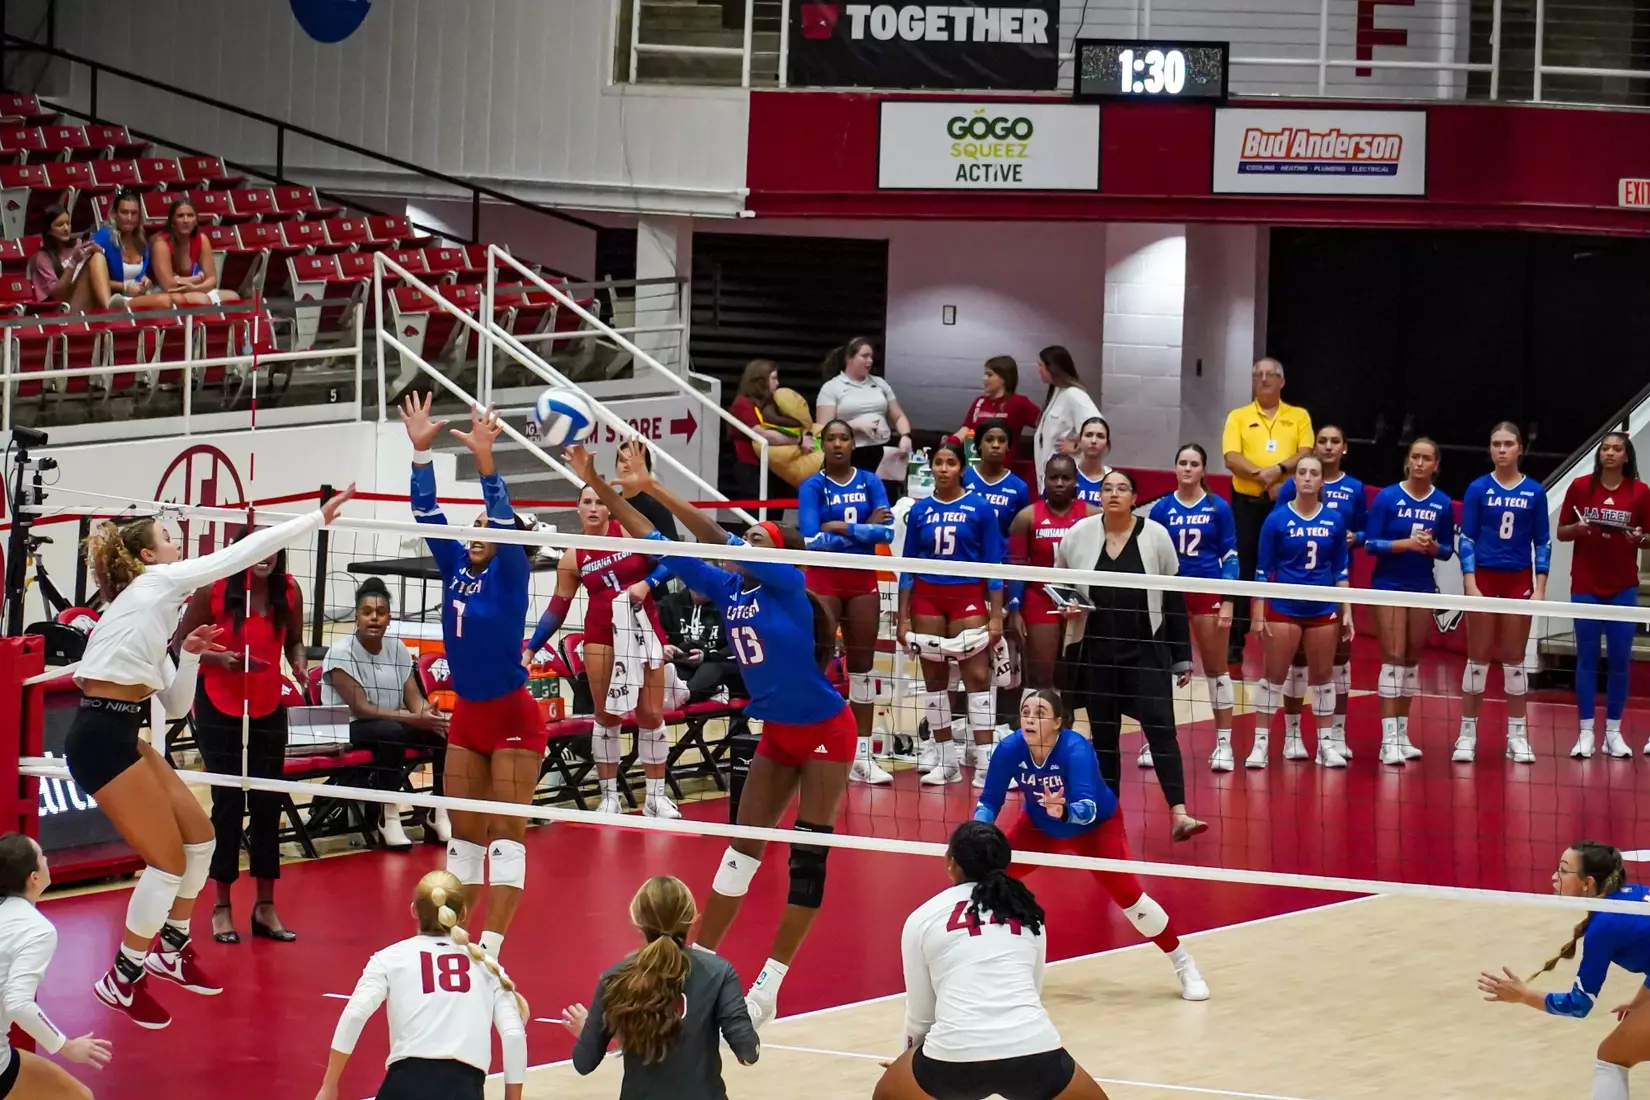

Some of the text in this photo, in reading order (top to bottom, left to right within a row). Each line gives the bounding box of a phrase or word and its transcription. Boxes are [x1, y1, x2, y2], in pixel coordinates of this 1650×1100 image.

[846, 4, 1049, 44] TOGETHER
[1119, 49, 1186, 94] 1:30
[947, 116, 1033, 140] GOGO
[950, 143, 1028, 160] SQUEEZ
[1242, 128, 1402, 161] Bud Anderson
[330, 389, 336, 402] 5
[843, 492, 866, 503] TECH
[986, 493, 1009, 506] TECH
[1487, 496, 1528, 508] LA TECH
[926, 511, 967, 524] LA TECH
[1170, 514, 1210, 525] LA TECH
[1398, 508, 1437, 521] LA TECH
[1583, 507, 1632, 522] LA TECH
[1290, 527, 1329, 538] LA TECH
[1499, 511, 1515, 539] 8
[934, 526, 957, 555] 15
[1178, 529, 1201, 556] 12
[1304, 541, 1318, 569] 3
[731, 627, 764, 664] 13
[105, 701, 136, 713] NIKE
[549, 703, 556, 718] G
[1021, 773, 1036, 786] LA
[419, 951, 471, 994] 18
